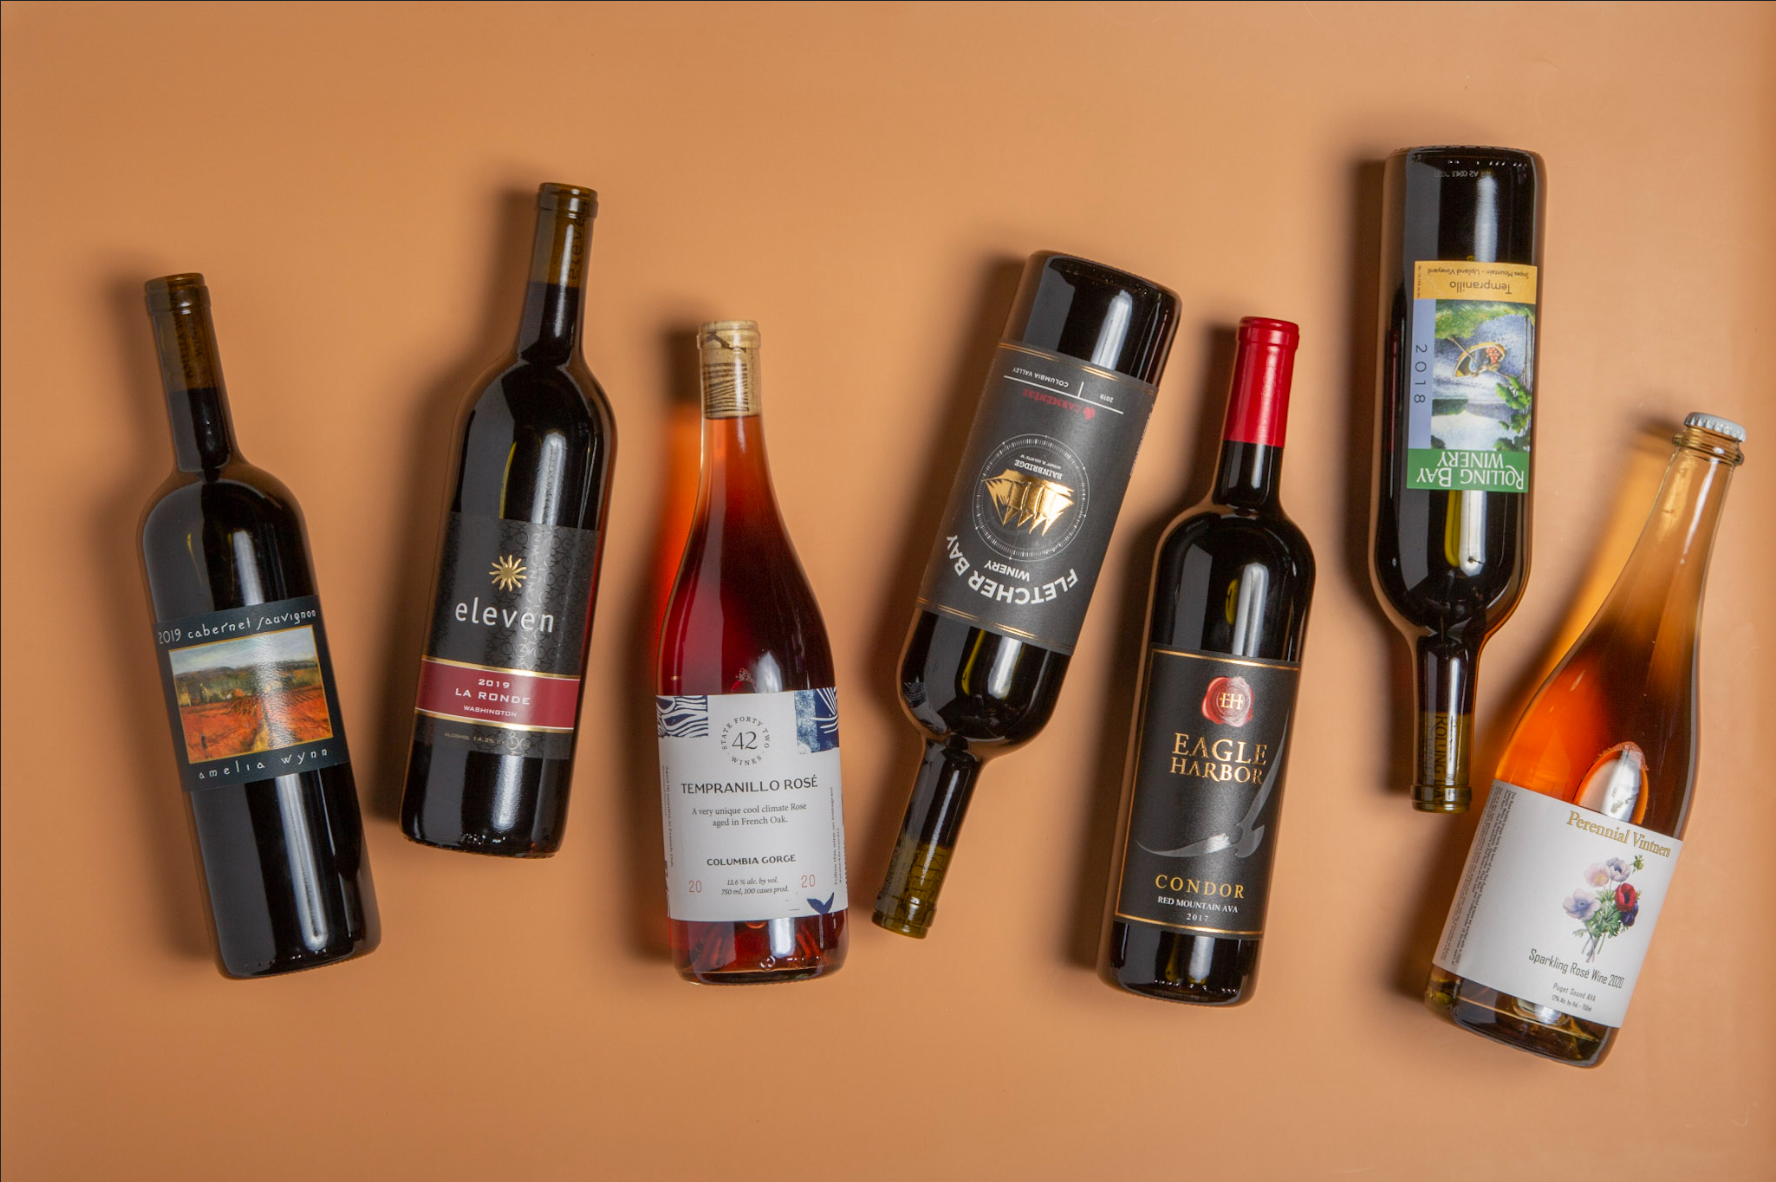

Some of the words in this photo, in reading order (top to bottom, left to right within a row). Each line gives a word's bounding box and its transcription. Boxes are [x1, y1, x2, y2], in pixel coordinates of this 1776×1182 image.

[1428, 268, 1456, 276] Vineyard
[1456, 268, 1481, 276] Upland
[1486, 269, 1512, 278] Mountain
[1449, 281, 1512, 294] Tempranillo
[1012, 366, 1033, 378] VALLEY
[1033, 372, 1069, 388] COLUMBIA
[1414, 344, 1428, 404] 2018
[1100, 393, 1114, 403] 2019
[1014, 458, 1063, 480] BAINBRIDGE
[1437, 451, 1504, 470] WINERY
[1416, 467, 1452, 488] BAY
[1460, 466, 1525, 490] ROLLING
[946, 534, 971, 577] BAY
[984, 559, 1030, 582] WINERY
[968, 568, 1079, 606] FLETCHER
[454, 596, 554, 633] eleven
[158, 628, 182, 645] 2019
[187, 617, 251, 640] cabernet
[478, 678, 511, 690] 2019
[454, 687, 472, 698] LA
[478, 690, 531, 706] RONDE
[1220, 692, 1244, 711] EH
[463, 704, 518, 718] WASHINGTON
[720, 722, 733, 751] STATE
[734, 716, 764, 727] FORTY
[762, 727, 770, 749] TWO
[731, 730, 758, 751] 42
[1174, 732, 1267, 766] EAGLE
[198, 760, 266, 780] amelia
[281, 748, 328, 766] wynn
[730, 754, 762, 766] WINES
[1170, 756, 1263, 785] HARBOR
[680, 778, 780, 794] TEMPRANILLO
[784, 774, 818, 790] ROSÉ
[692, 807, 698, 816] A
[698, 808, 714, 818] very
[714, 806, 742, 818] unique
[742, 804, 760, 814] cool
[761, 803, 789, 814] climate
[790, 802, 807, 812] Rose
[712, 818, 730, 829] aged
[731, 817, 740, 826] in
[740, 816, 768, 826] French
[769, 815, 788, 825] Oak.
[1566, 810, 1631, 845] Perennial
[1632, 831, 1672, 858] Vintners
[706, 856, 760, 866] COLUMBIA
[761, 854, 796, 865] GORGE
[688, 880, 702, 894] 20
[720, 888, 732, 896] 750
[744, 886, 756, 895] 100
[756, 886, 772, 895] cases
[772, 884, 790, 896] prod.
[726, 878, 740, 886] 13.6
[740, 878, 746, 886] %
[747, 876, 758, 885] alc.
[758, 876, 768, 886] by
[768, 876, 779, 884] vol.
[800, 874, 816, 888] 20
[1154, 874, 1245, 900] CONDOR
[1158, 896, 1175, 906] RED
[1176, 898, 1220, 912] MOUNTAIN
[1222, 902, 1238, 914] AVA
[1186, 912, 1210, 923] 2017
[1528, 948, 1569, 977] Sparkling
[1570, 962, 1590, 980] Rosé
[1592, 968, 1608, 986] Wine
[1608, 974, 1624, 990] 2020
[1552, 982, 1570, 996] Puget
[1570, 986, 1586, 1000] Sound
[1586, 992, 1596, 1002] AVA
